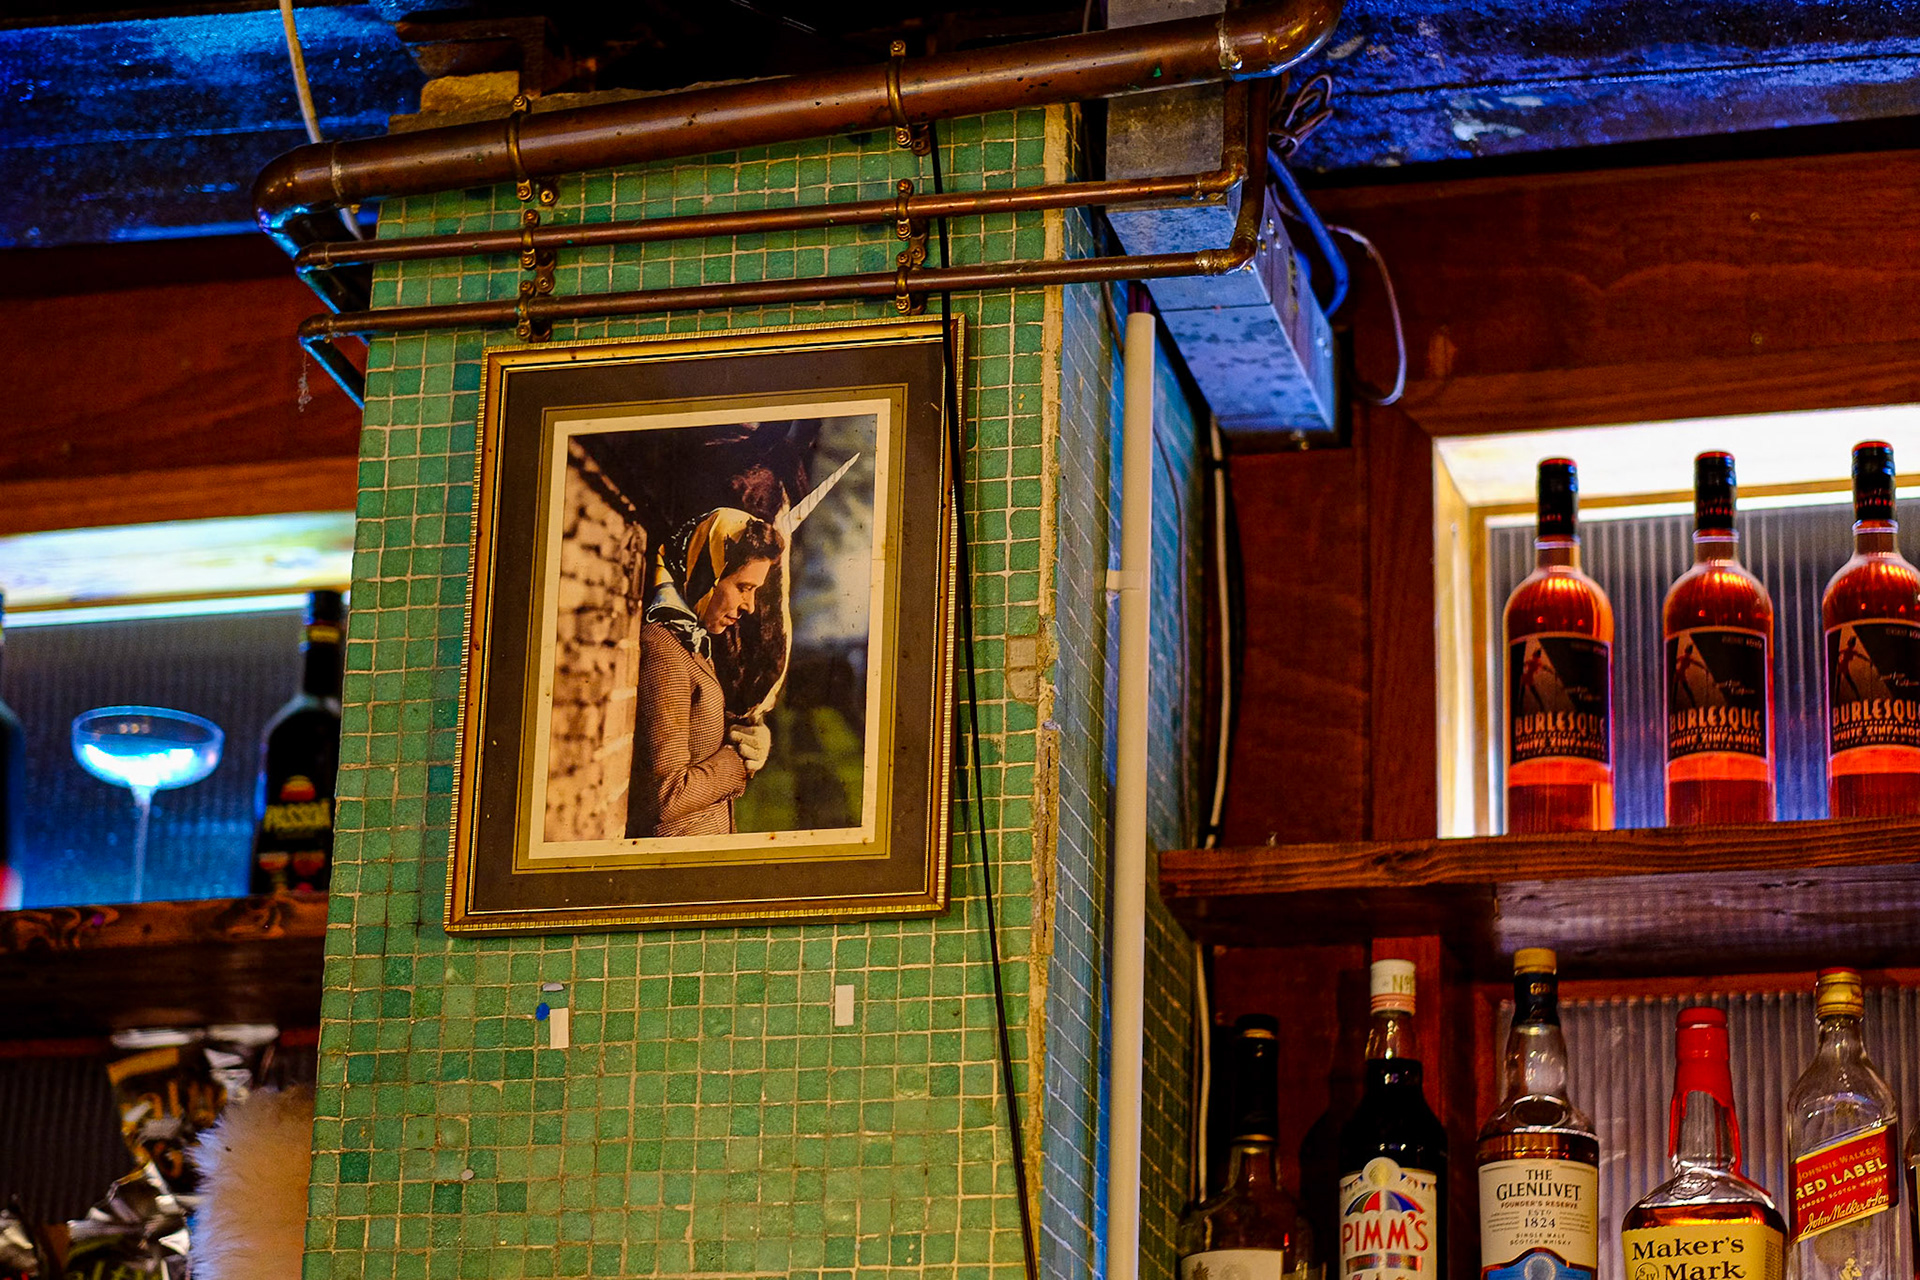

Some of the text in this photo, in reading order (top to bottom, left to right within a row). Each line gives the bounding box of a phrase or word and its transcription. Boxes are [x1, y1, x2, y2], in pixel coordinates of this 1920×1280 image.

[1515, 711, 1605, 737] BURLESQUE
[1670, 705, 1760, 734] BURLESQUE
[1833, 698, 1920, 728] BURLESQU
[1670, 734, 1698, 749] WHITE
[1833, 728, 1863, 742] WHITE
[1525, 1169, 1553, 1181] THE
[1797, 1146, 1878, 1182] JOHNNIE WALKER
[1795, 1157, 1888, 1200] RED LABEL
[1496, 1182, 1582, 1202] GLENLIVET
[1500, 1201, 1578, 1210] FOUNDER'S RESERVE
[1342, 1211, 1429, 1256] PIMM'S
[1524, 1217, 1557, 1229] 1824
[1632, 1236, 1744, 1261] Maker's
[1663, 1261, 1744, 1280] Mark
